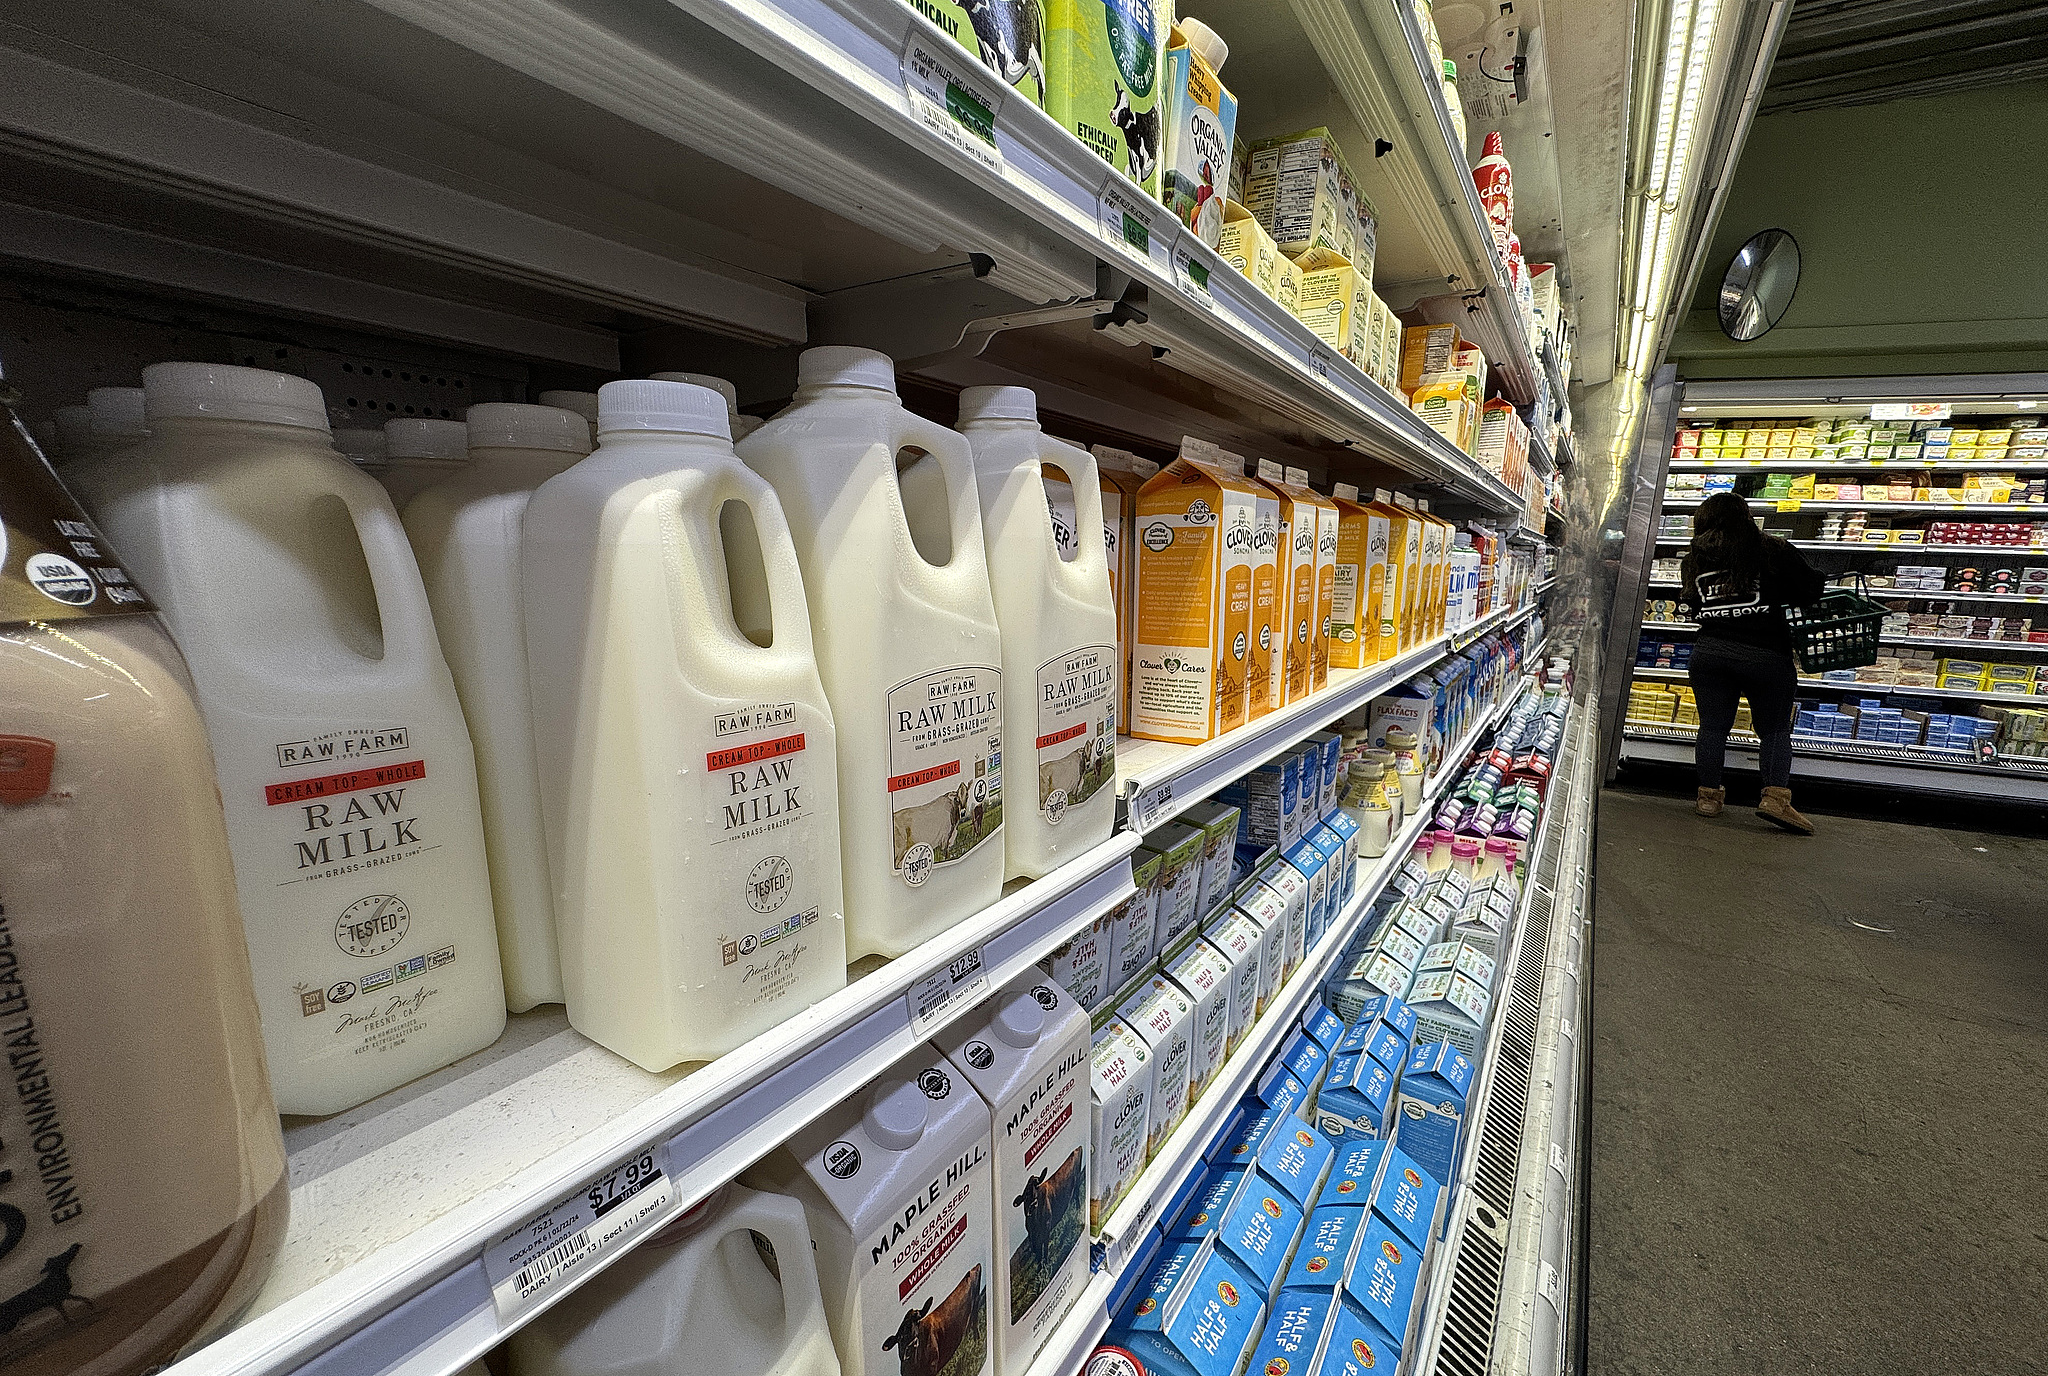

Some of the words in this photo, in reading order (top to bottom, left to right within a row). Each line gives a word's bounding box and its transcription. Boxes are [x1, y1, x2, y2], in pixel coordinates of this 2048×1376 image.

[910, 0, 958, 39] HICALLY
[913, 47, 936, 72] ORGANIC
[917, 66, 931, 81] MILK
[1118, 52, 1131, 76] FAT
[1131, 73, 1145, 89] FREE
[1190, 56, 1205, 82] Heavy
[1187, 81, 1203, 104] Cream
[1188, 68, 1212, 103] Whipping
[954, 105, 993, 140] $6.99
[1077, 122, 1118, 153] ETHICALLY
[1079, 138, 1114, 165] OURCED
[1191, 114, 1227, 167] ORGANIC
[1194, 137, 1224, 172] VALLEY
[36, 565, 76, 577] USDA
[1066, 660, 1080, 674] RAW
[1081, 656, 1097, 669] FARM
[1140, 659, 1164, 670] Clover
[1181, 663, 1206, 673] Cares
[930, 684, 950, 697] RAW
[952, 679, 974, 693] FARM
[1044, 676, 1080, 702] RAW
[1081, 664, 1113, 693] MILK
[1064, 688, 1101, 708] GRASS-GRAZED
[718, 715, 750, 732] RAW
[756, 707, 793, 725] FARM
[898, 703, 946, 732] RAW
[952, 691, 997, 721] MILK
[1377, 706, 1395, 715] FLAX
[1396, 708, 1419, 718] FACTS
[313, 731, 343, 742] FAMILY
[912, 732, 926, 742] FROM
[927, 718, 980, 741] GRASS-GRAZED
[283, 742, 334, 762] RAW
[344, 732, 403, 753] FARM
[712, 752, 743, 767] CREAM
[748, 746, 764, 759] TOP
[774, 737, 801, 752] WHOLE
[274, 781, 324, 800] CREAM
[332, 776, 358, 790] TOP
[376, 764, 419, 783] WHOLE
[728, 758, 794, 796] RAW
[898, 775, 920, 788] CREAM
[922, 771, 934, 782] TOP
[939, 763, 958, 777] WHOLE
[301, 788, 406, 832] RAW
[722, 786, 802, 830] MILK
[294, 817, 421, 870] MILK
[741, 818, 790, 839] GRASS-GRAZED
[306, 873, 323, 882] FROM
[325, 853, 403, 878] GRASS-GRAZED
[908, 857, 929, 874] TESTED
[753, 874, 785, 899] TESTED
[347, 913, 398, 942] TESTED
[724, 945, 735, 955] SOY
[949, 950, 978, 978] $12.99
[304, 993, 320, 1004] SOY
[305, 1003, 322, 1015] free
[1093, 1048, 1116, 1069] ORGANIC
[1162, 1040, 1187, 1073] CLOVER
[1109, 1067, 1128, 1087] HALF
[1006, 1072, 1054, 1137] MAPLE
[1020, 1116, 1039, 1140] 100%
[1040, 1078, 1075, 1119] GRASSFED
[1033, 1100, 1064, 1138] ORGANIC
[1114, 1093, 1144, 1130] CLOVER
[3, 1015, 83, 1226] ENVIRONMENTAL
[830, 1146, 850, 1165] USDA
[1030, 1128, 1053, 1156] WHOLE
[1289, 1150, 1308, 1178] HALF
[588, 1155, 654, 1210] $7.99
[632, 1183, 642, 1194] QT
[871, 1179, 941, 1266] MAPLE
[1403, 1193, 1418, 1224] HALF
[532, 1218, 554, 1237] 7521
[892, 1235, 920, 1269] 100%
[921, 1184, 970, 1238] GRASSFED
[912, 1212, 956, 1264] ORGANIC
[1252, 1222, 1273, 1256] HALF
[1314, 1220, 1333, 1250] HALF
[521, 1272, 552, 1300] DAIRY
[562, 1254, 585, 1272] Aisle
[586, 1243, 597, 1255] 13
[603, 1226, 623, 1244] Sect
[624, 1216, 634, 1228] 11
[639, 1201, 660, 1219] Shelf
[660, 1195, 666, 1203] 3
[908, 1248, 940, 1286] WHOLE
[941, 1225, 960, 1252] MILK
[1380, 1272, 1400, 1309] HALF
[1204, 1315, 1228, 1356] HALF
[1276, 1310, 1297, 1347] HALF
[1151, 1337, 1160, 1347] TO
[1162, 1347, 1186, 1363] OPEN
